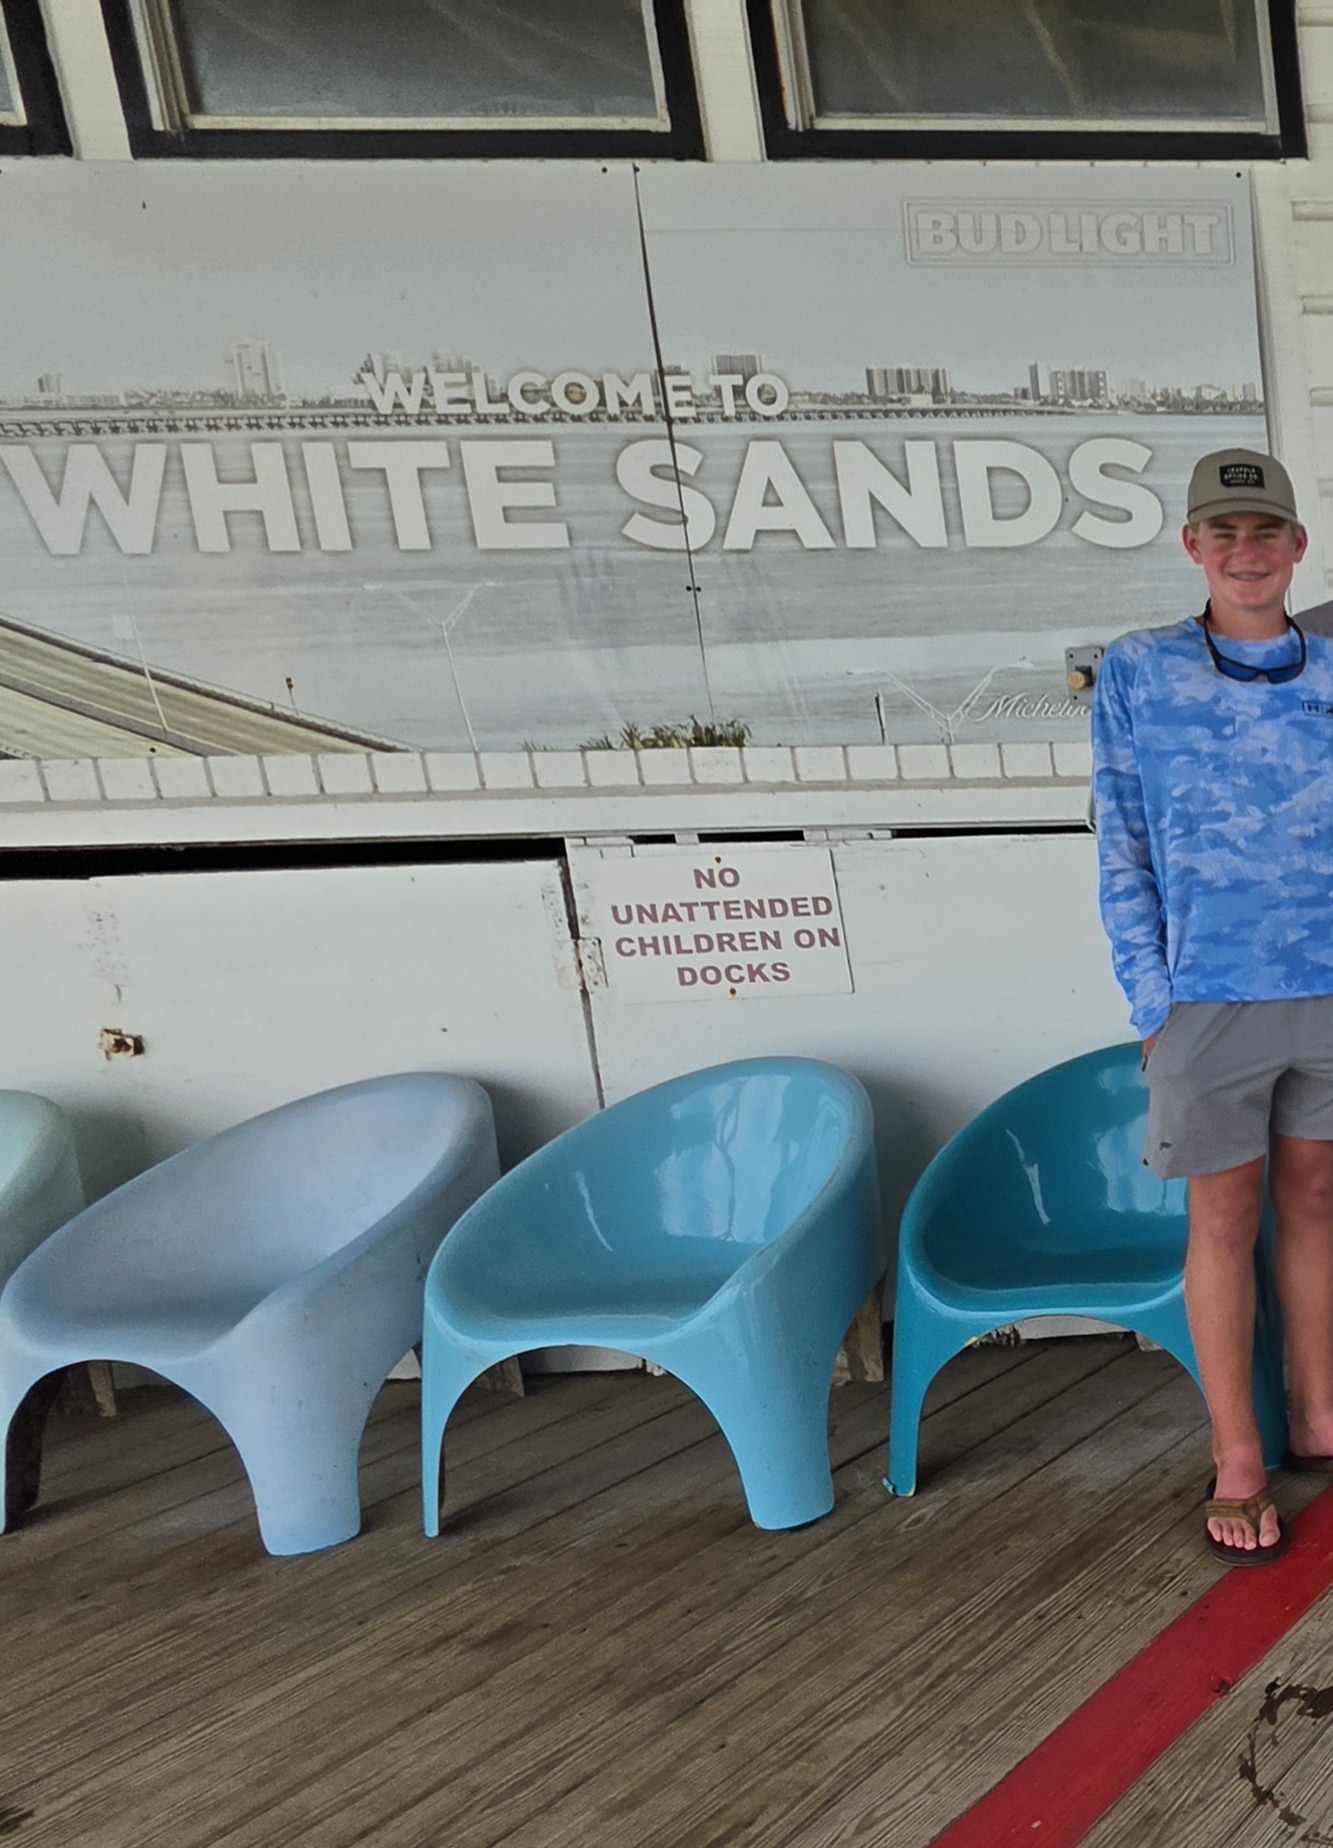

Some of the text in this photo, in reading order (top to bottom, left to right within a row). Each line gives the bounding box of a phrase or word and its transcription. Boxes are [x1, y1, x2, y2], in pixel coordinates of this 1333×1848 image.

[917, 212, 1221, 255] BUD LIGHT
[363, 371, 789, 418] WELCOME TO
[0, 436, 1164, 556] WHITE SANDS
[693, 867, 740, 889] NO
[611, 896, 833, 925] UNATTENDED
[615, 928, 841, 957] CHILDREN ON
[677, 962, 791, 986] DOCKS
